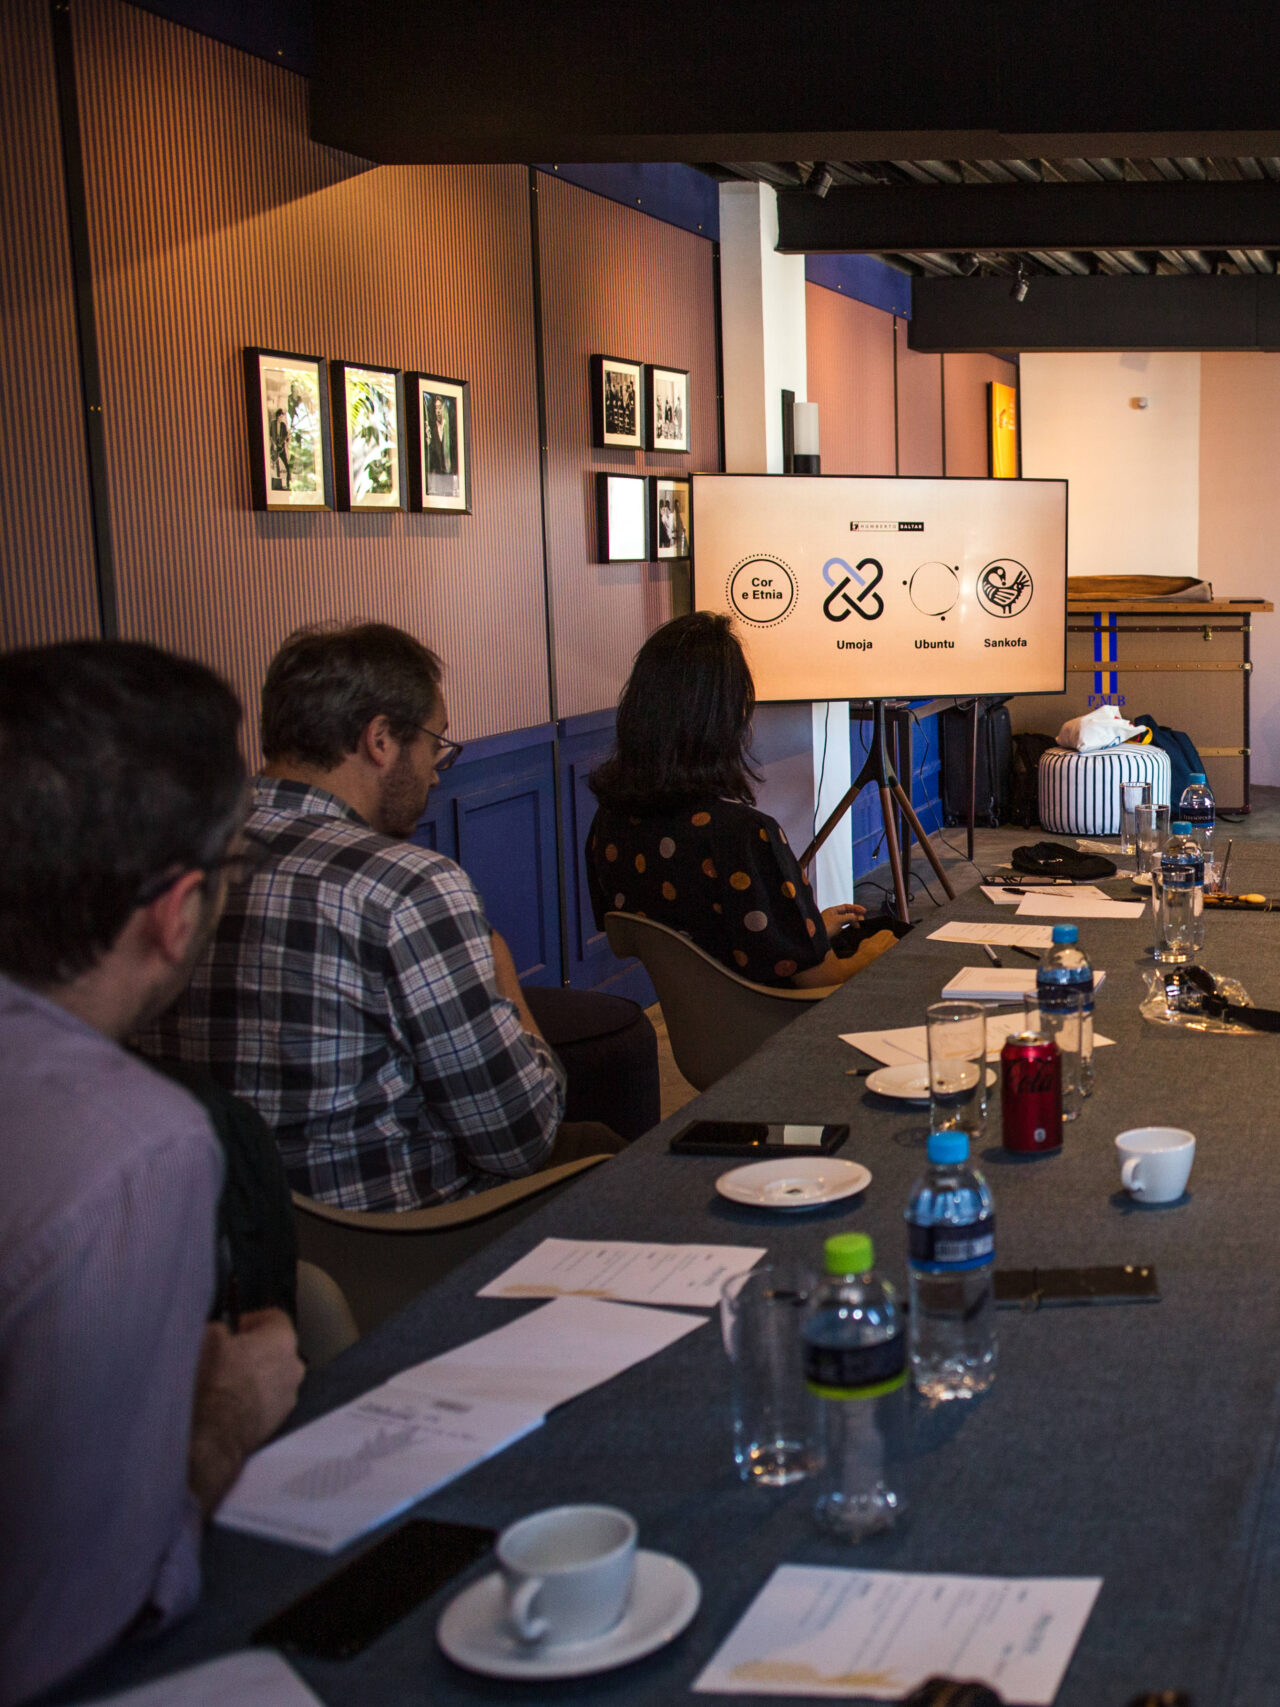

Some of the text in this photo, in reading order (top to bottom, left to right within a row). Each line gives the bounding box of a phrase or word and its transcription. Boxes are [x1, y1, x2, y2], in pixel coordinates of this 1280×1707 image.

[751, 577, 773, 587] Cor
[742, 589, 783, 600] e Etnia
[836, 639, 873, 651] Umoja
[914, 639, 955, 649] Ubuntu
[984, 637, 1028, 648] Sankofa
